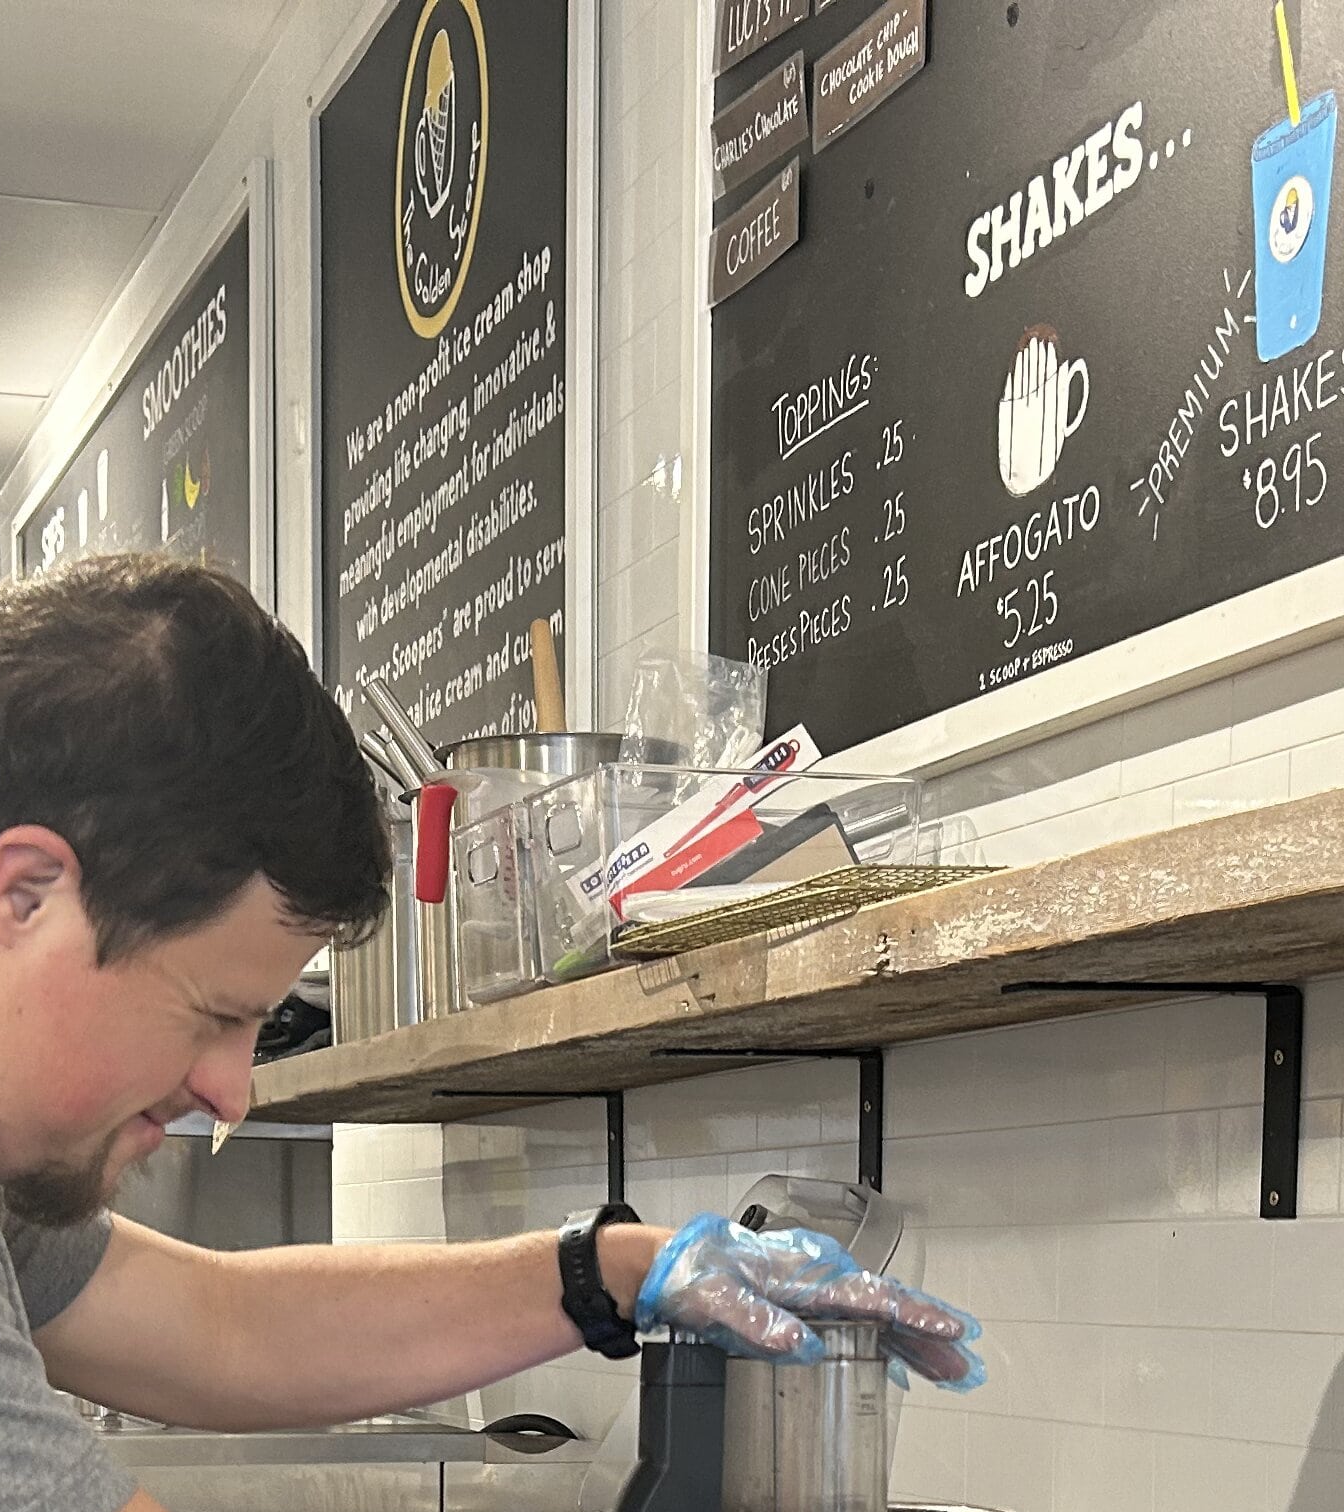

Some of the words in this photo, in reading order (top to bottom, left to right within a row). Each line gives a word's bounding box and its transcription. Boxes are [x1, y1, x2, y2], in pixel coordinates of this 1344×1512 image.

[820, 38, 874, 97] CHOCOLATE
[849, 59, 884, 105] COOKIE
[886, 25, 919, 74] DOUGH
[448, 120, 481, 262] Scoop
[713, 120, 755, 172] CHARLIE'S
[414, 251, 452, 304] Golden
[725, 198, 781, 276] COFFEE
[142, 284, 227, 442] SMOOTHIES
[346, 426, 365, 471] We
[366, 415, 383, 451] are
[385, 402, 393, 433] a
[394, 335, 451, 425] non-profit
[453, 327, 471, 365] ice
[474, 282, 514, 346] cream
[517, 245, 551, 304] shop
[1148, 307, 1240, 504] PREMIUM
[344, 469, 392, 545] providing
[394, 439, 411, 488] life
[413, 396, 470, 469] changing,
[473, 327, 545, 415] innovative,
[545, 299, 556, 349] &
[339, 517, 396, 598] meaningful
[397, 455, 469, 548] employment
[471, 440, 490, 486] for
[492, 373, 564, 470] individuals
[748, 451, 854, 555] SPRINKLES
[875, 419, 904, 470] .25
[1243, 432, 1328, 529] $8.95
[356, 596, 378, 643] with
[380, 525, 462, 625] developmental
[466, 478, 537, 557] disabilities.
[453, 601, 471, 638] are
[474, 555, 514, 636] proud
[517, 555, 532, 597] to
[535, 535, 565, 585] serv
[748, 563, 792, 622] CONE
[798, 526, 851, 592] PIECES
[873, 491, 906, 543] .25
[957, 485, 1101, 598] AFFOGATO
[799, 594, 852, 653] PIECES
[870, 554, 908, 612] .25
[996, 569, 1059, 649] $5.25
[425, 682, 442, 723] ice
[445, 661, 483, 707] cream
[486, 631, 509, 683] and
[989, 656, 1021, 686] SCOOP
[1032, 638, 1074, 670] ESPRESSO
[501, 692, 516, 734] of
